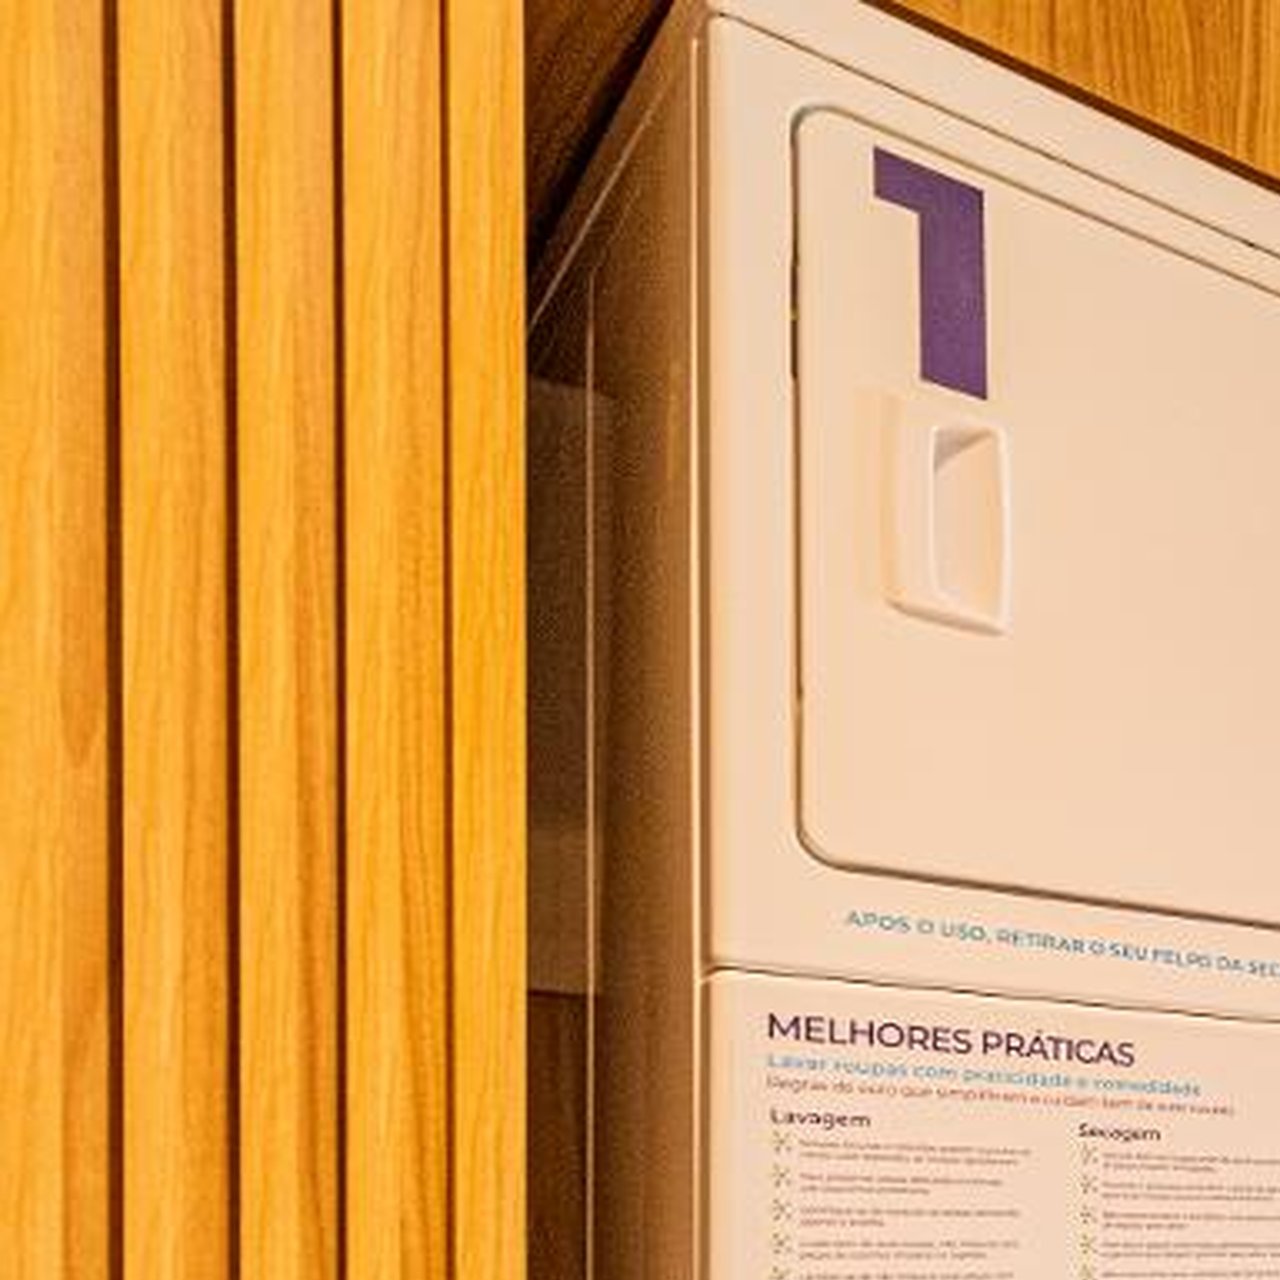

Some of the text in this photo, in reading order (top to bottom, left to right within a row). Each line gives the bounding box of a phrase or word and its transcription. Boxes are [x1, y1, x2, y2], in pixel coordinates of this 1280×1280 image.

[873, 145, 988, 401] 1
[917, 914, 935, 936] O
[996, 926, 1086, 955] RETIRAR
[1088, 940, 1106, 957] O
[1108, 941, 1149, 963] SEU
[1216, 954, 1244, 973] DA
[767, 1012, 1136, 1068] MELHORES PRÁTICAS
[833, 1059, 907, 1080] roupas
[913, 1064, 958, 1080] com
[770, 1107, 872, 1134] Lavagem
[1077, 1121, 1162, 1145] Secagem
